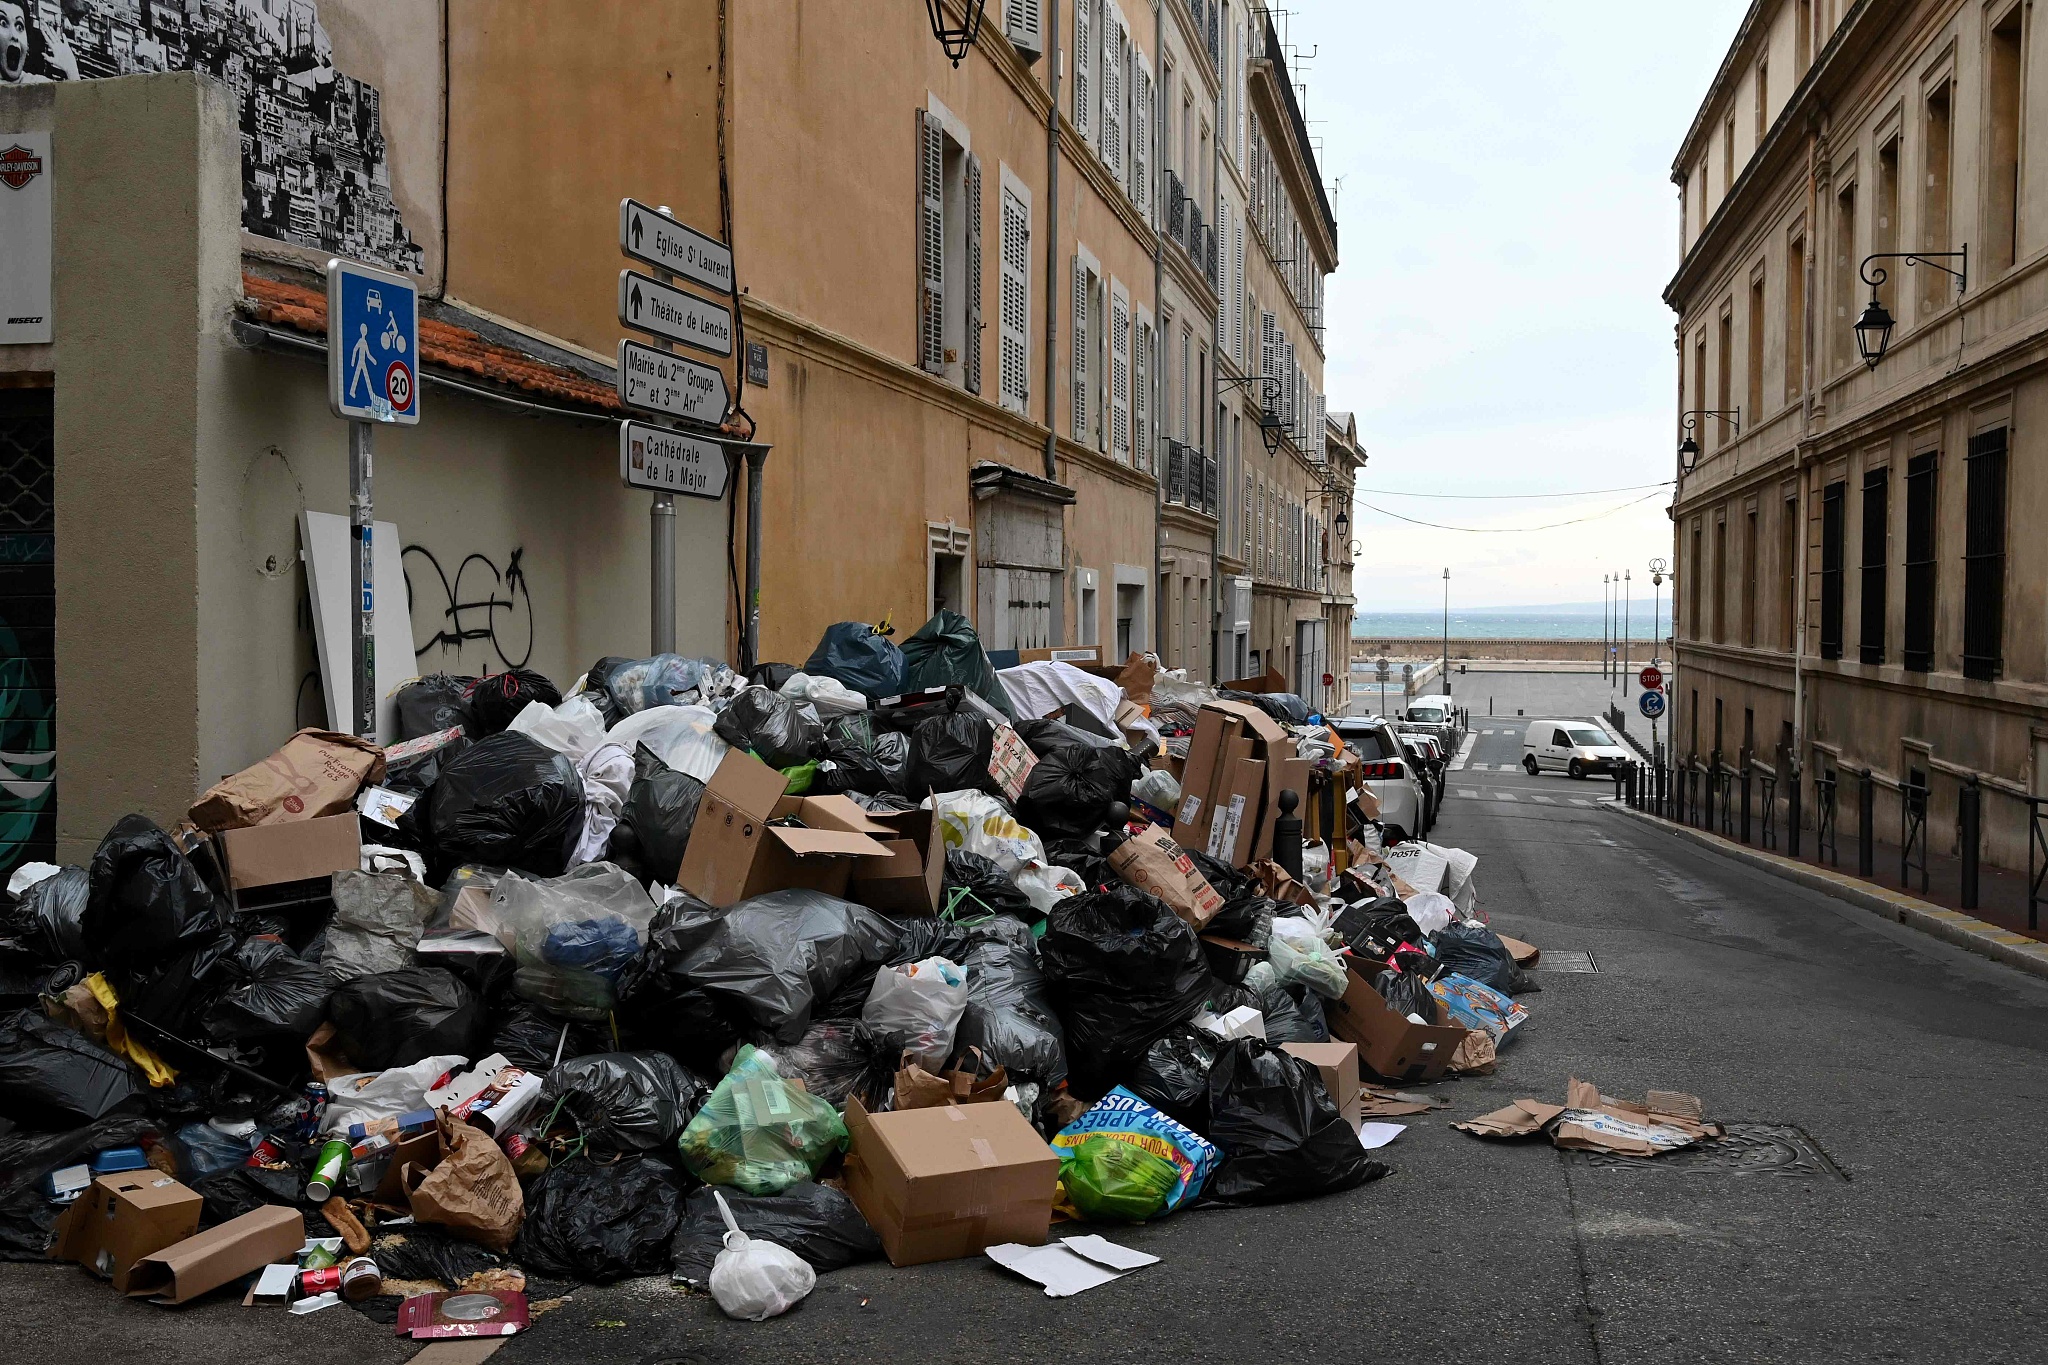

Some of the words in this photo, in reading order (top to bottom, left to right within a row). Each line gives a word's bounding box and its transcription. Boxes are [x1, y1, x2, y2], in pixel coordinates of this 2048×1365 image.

[0, 161, 39, 172] RLEY-DAVIDSON
[656, 230, 683, 258] Eglise
[688, 245, 696, 263] St
[699, 250, 729, 279] Laurent
[650, 297, 682, 325] Théâtre
[687, 311, 696, 330] de
[701, 315, 728, 340] Lenche
[629, 350, 654, 375] Mairie
[658, 360, 667, 379] du
[688, 368, 714, 395] Groupe
[391, 376, 408, 397] 20
[650, 388, 659, 403] et
[647, 436, 700, 464] Cathédrale
[647, 460, 658, 480] de
[665, 464, 674, 483] la
[680, 466, 706, 491] Major
[1642, 674, 1660, 682] STOP
[1004, 741, 1022, 763] PIZZA
[322, 768, 340, 782] T65
[324, 760, 350, 780] Rouge
[332, 758, 361, 783] Fromen
[1390, 850, 1420, 858] POSTE
[1089, 1094, 1151, 1113] AUSS
[1073, 1112, 1140, 1133] APRÈS
[1142, 1117, 1198, 1152] POUR
[1140, 1136, 1169, 1157] POUR
